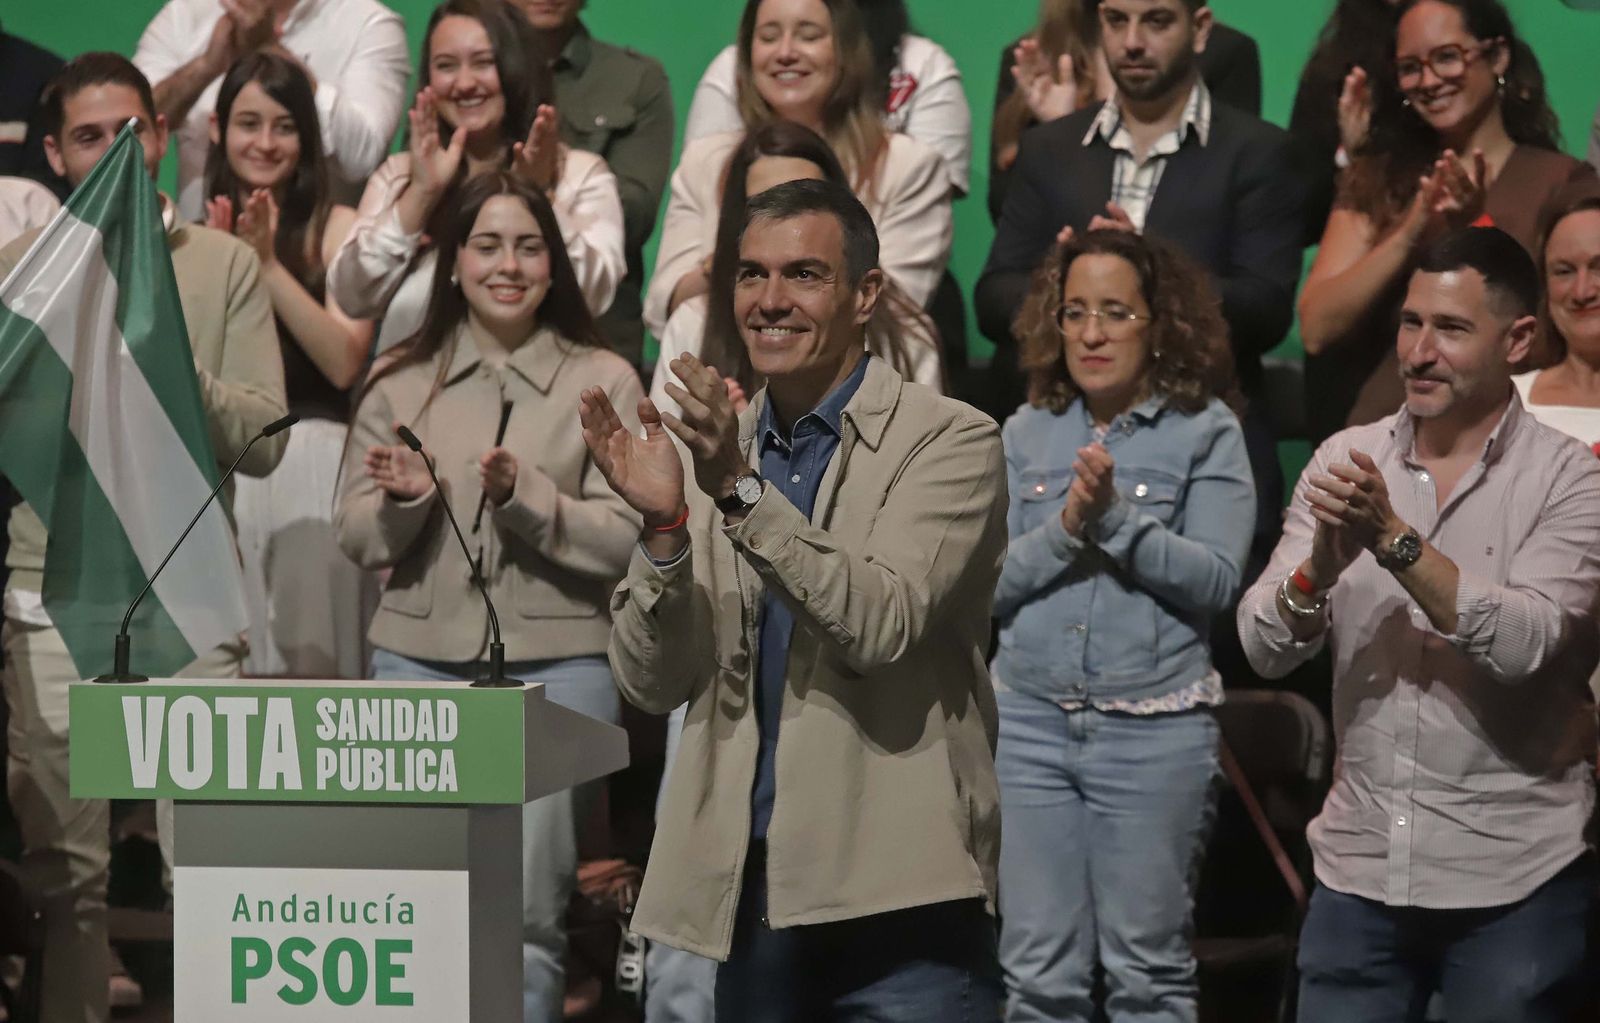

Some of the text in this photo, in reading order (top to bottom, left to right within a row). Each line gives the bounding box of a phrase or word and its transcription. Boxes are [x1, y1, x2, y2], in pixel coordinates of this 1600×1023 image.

[121, 695, 303, 791] VOTA
[315, 697, 459, 743] SANIDAD
[316, 741, 459, 793] PÚBLICA
[231, 893, 415, 925] Andalucía
[230, 936, 415, 1006] PSOE
